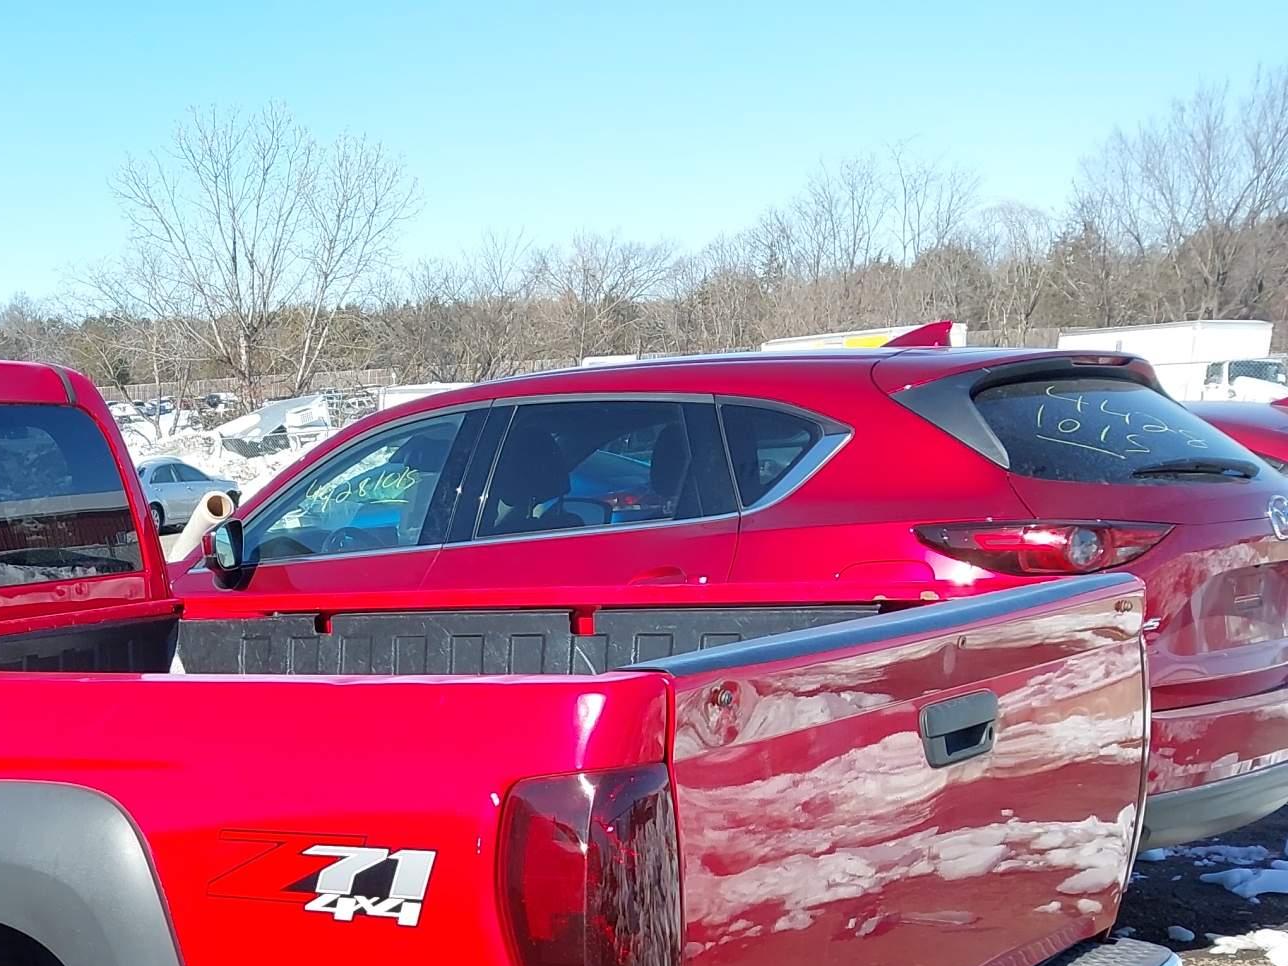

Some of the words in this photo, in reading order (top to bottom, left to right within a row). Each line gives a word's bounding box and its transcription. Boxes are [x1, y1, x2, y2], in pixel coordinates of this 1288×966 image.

[1037, 404, 1151, 453] 1015
[1045, 385, 1209, 449] 4428
[207, 828, 437, 906] Z71
